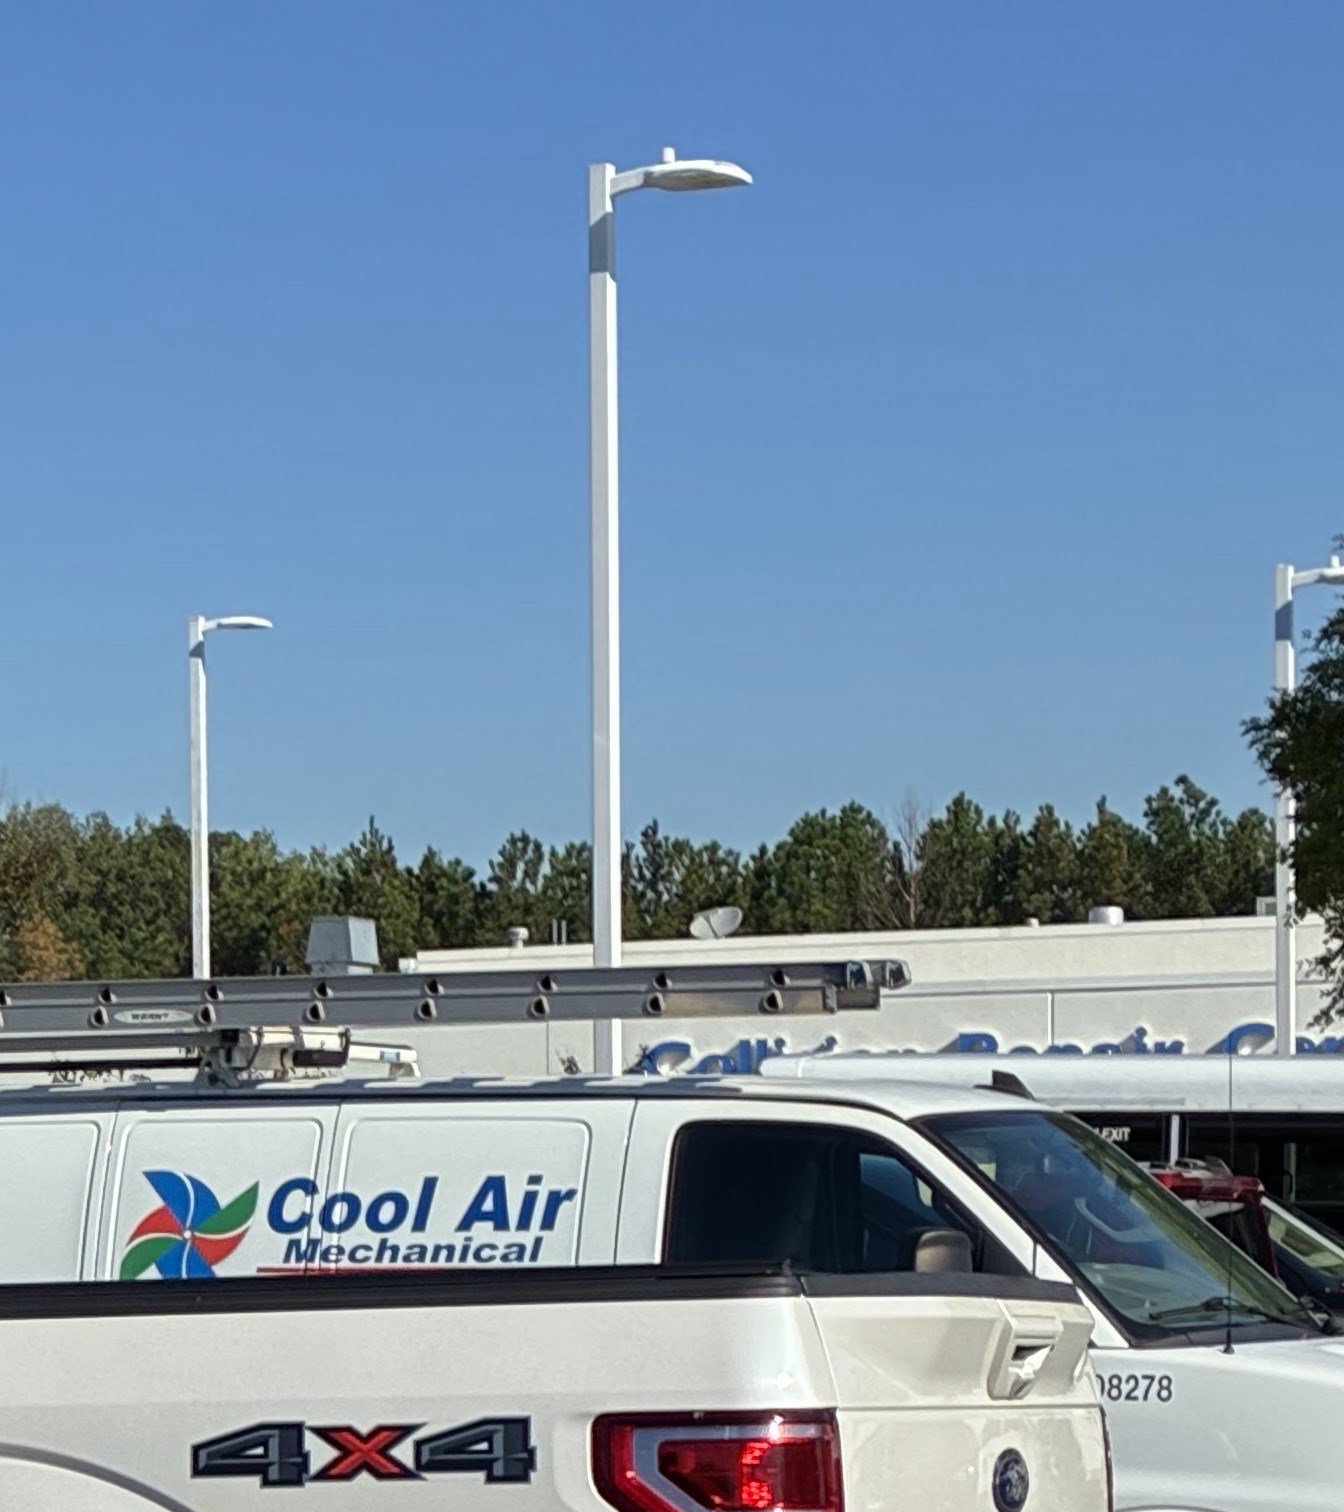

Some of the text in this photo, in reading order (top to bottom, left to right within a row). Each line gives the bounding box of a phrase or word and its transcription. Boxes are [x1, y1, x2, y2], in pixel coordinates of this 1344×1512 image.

[267, 1174, 578, 1234] Cool Air
[282, 1236, 544, 1264] Mechanical
